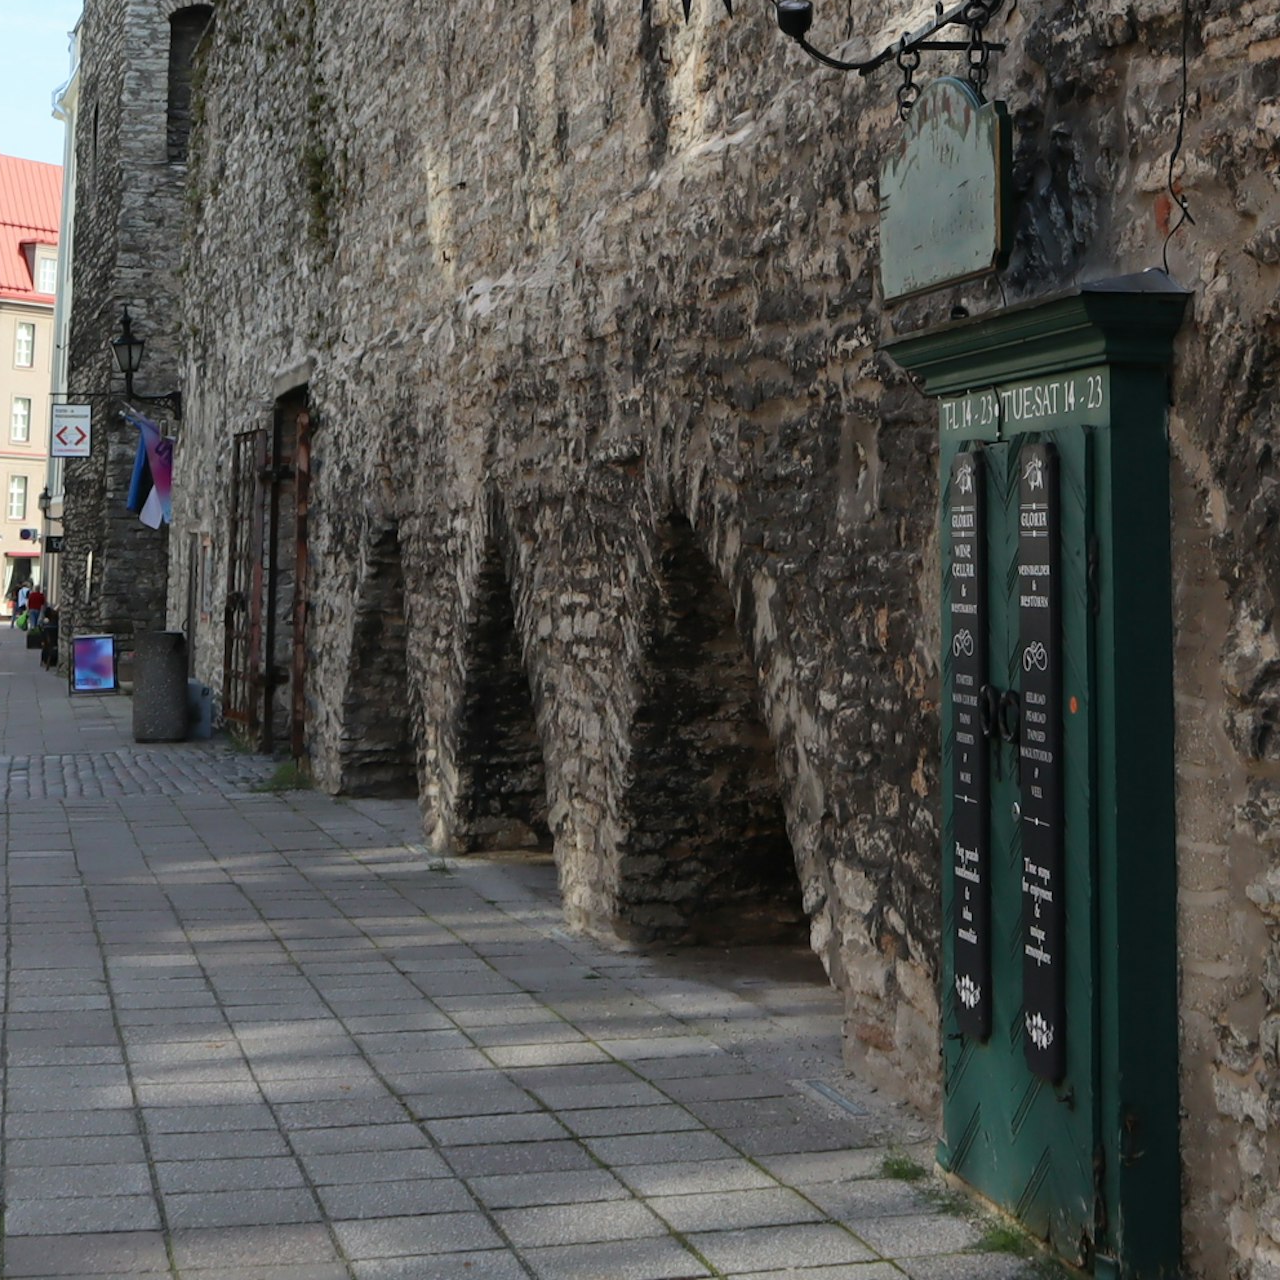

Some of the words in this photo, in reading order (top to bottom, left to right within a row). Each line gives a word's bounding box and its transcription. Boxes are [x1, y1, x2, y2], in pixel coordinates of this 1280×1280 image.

[1064, 380, 1075, 412] 14
[1087, 374, 1102, 409] 23
[961, 399, 971, 427] 14
[980, 395, 992, 425] 23
[951, 514, 974, 528] GLORIA
[1020, 511, 1047, 529] GLORIA
[951, 563, 975, 578] CELLAR
